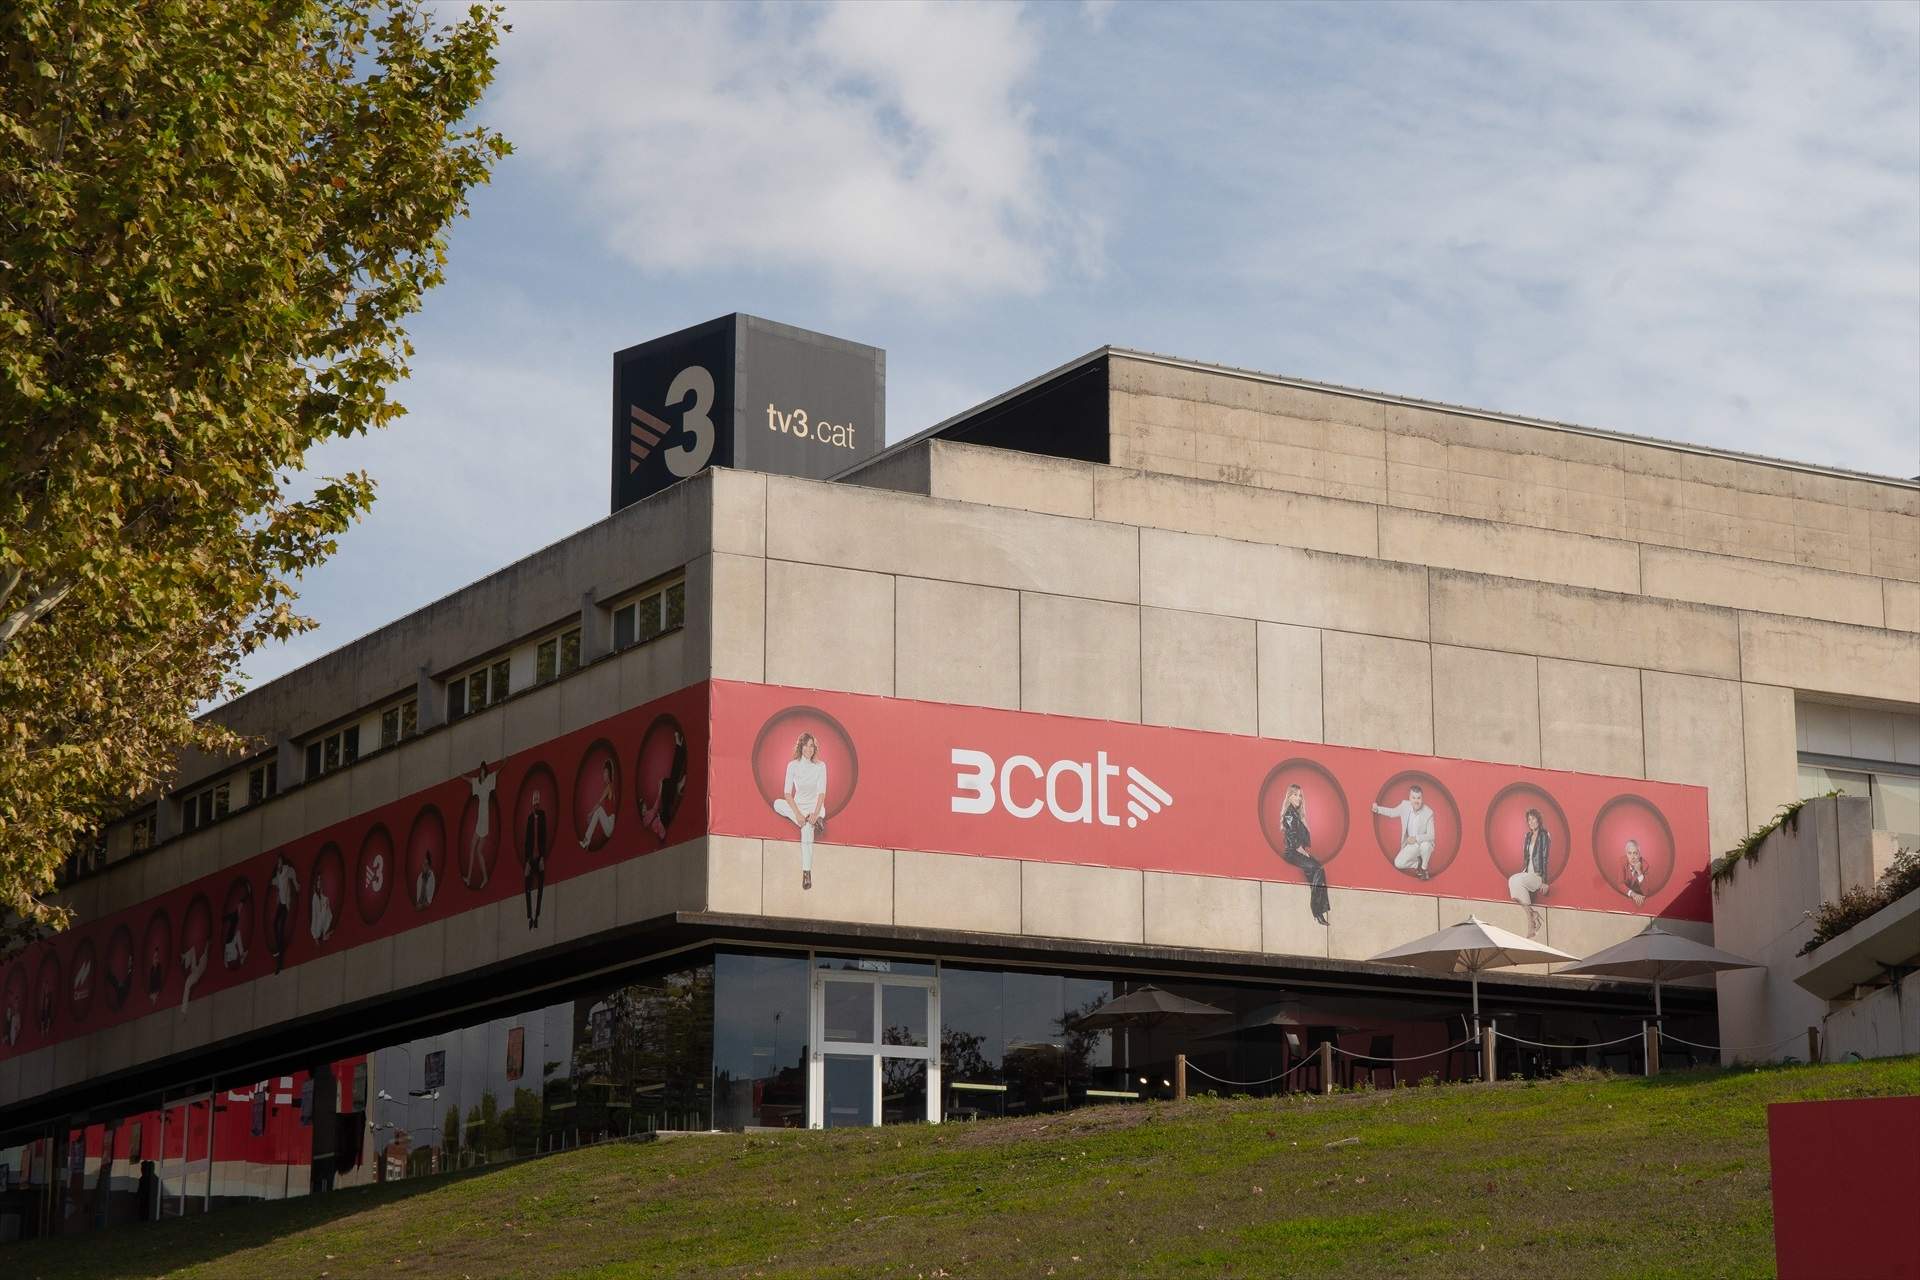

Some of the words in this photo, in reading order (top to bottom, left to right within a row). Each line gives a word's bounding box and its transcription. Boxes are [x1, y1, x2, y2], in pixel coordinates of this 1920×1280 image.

[664, 365, 715, 478] 3
[767, 403, 855, 449] tv3.cat
[951, 748, 1120, 826] 3cat
[371, 854, 384, 892] 3
